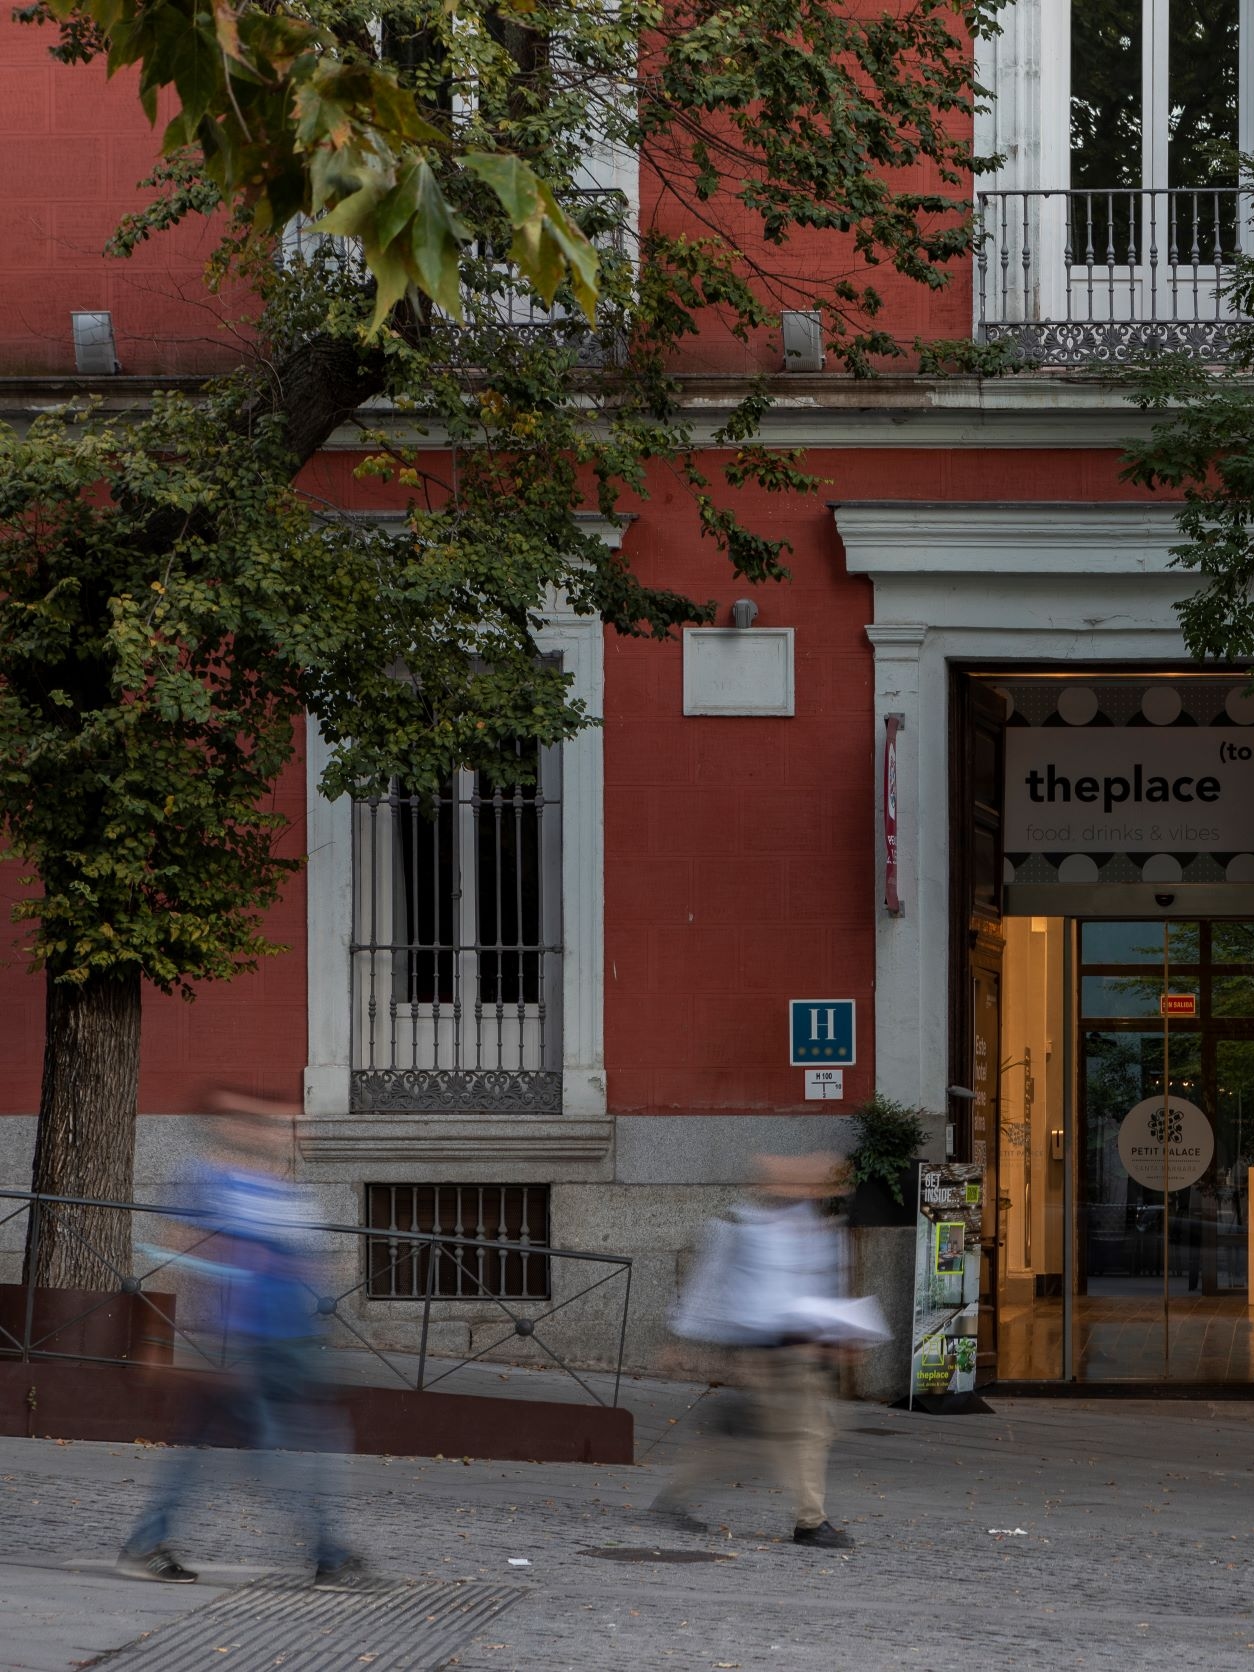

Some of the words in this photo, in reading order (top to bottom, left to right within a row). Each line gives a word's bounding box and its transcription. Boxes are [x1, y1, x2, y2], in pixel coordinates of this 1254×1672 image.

[1219, 740, 1252, 764] (to
[1025, 763, 1221, 814] theplace
[1026, 823, 1076, 842] food,
[1082, 823, 1144, 841] drinks
[1150, 825, 1163, 841] &
[1168, 823, 1220, 841] vibes
[808, 1008, 837, 1041] H
[816, 1072, 821, 1080] H
[822, 1072, 833, 1080] 100
[1131, 1147, 1159, 1156] PETIT
[925, 1173, 942, 1188] GET
[916, 1370, 949, 1381] theplace
